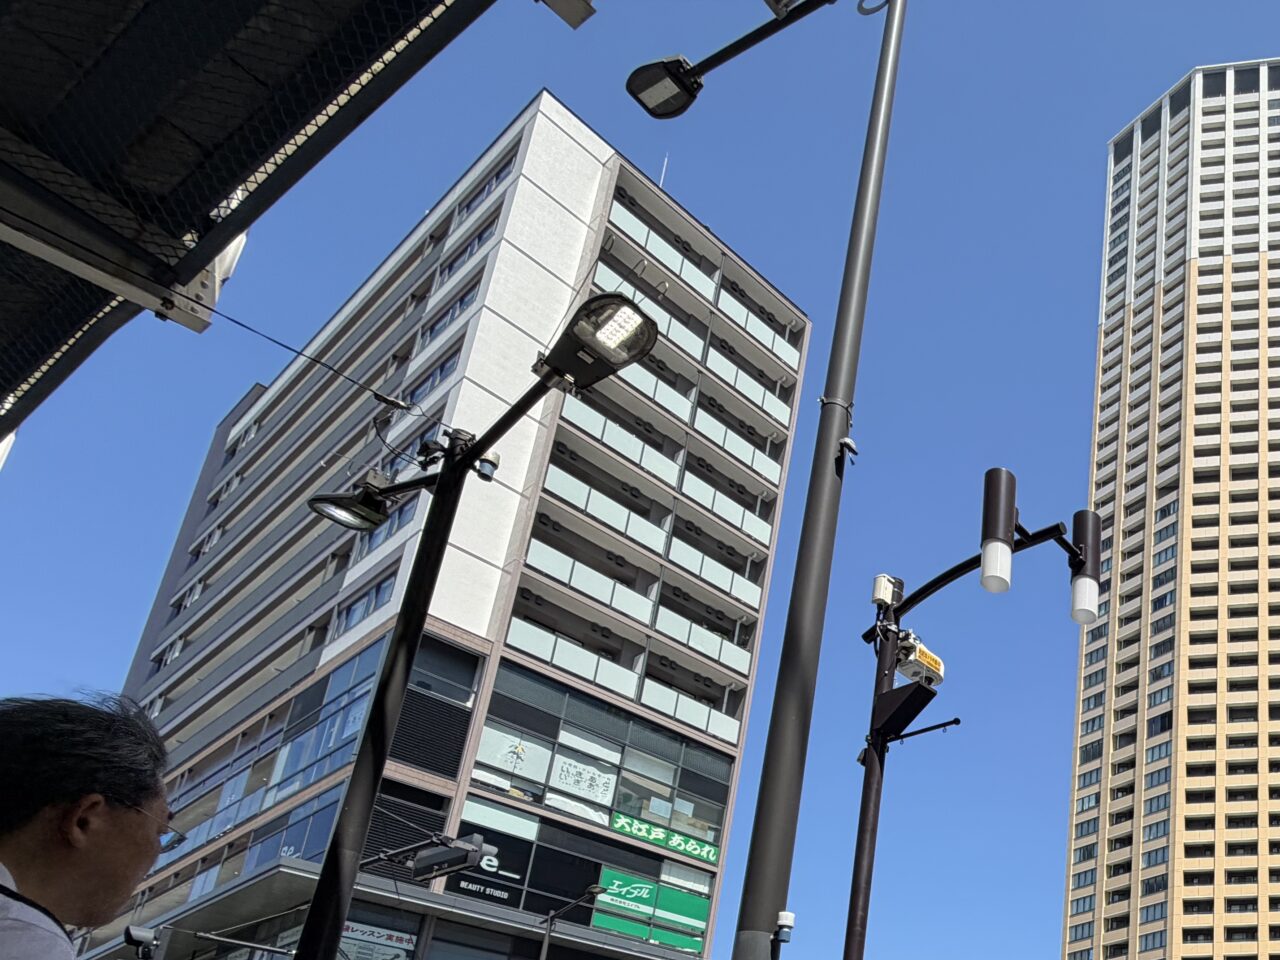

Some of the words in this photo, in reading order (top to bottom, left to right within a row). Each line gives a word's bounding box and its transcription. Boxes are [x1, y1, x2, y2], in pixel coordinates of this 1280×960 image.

[613, 815, 666, 840] 大江戸
[460, 881, 485, 893] BEAUTY
[485, 888, 509, 899] STUDIO
[607, 880, 653, 898] エイブル
